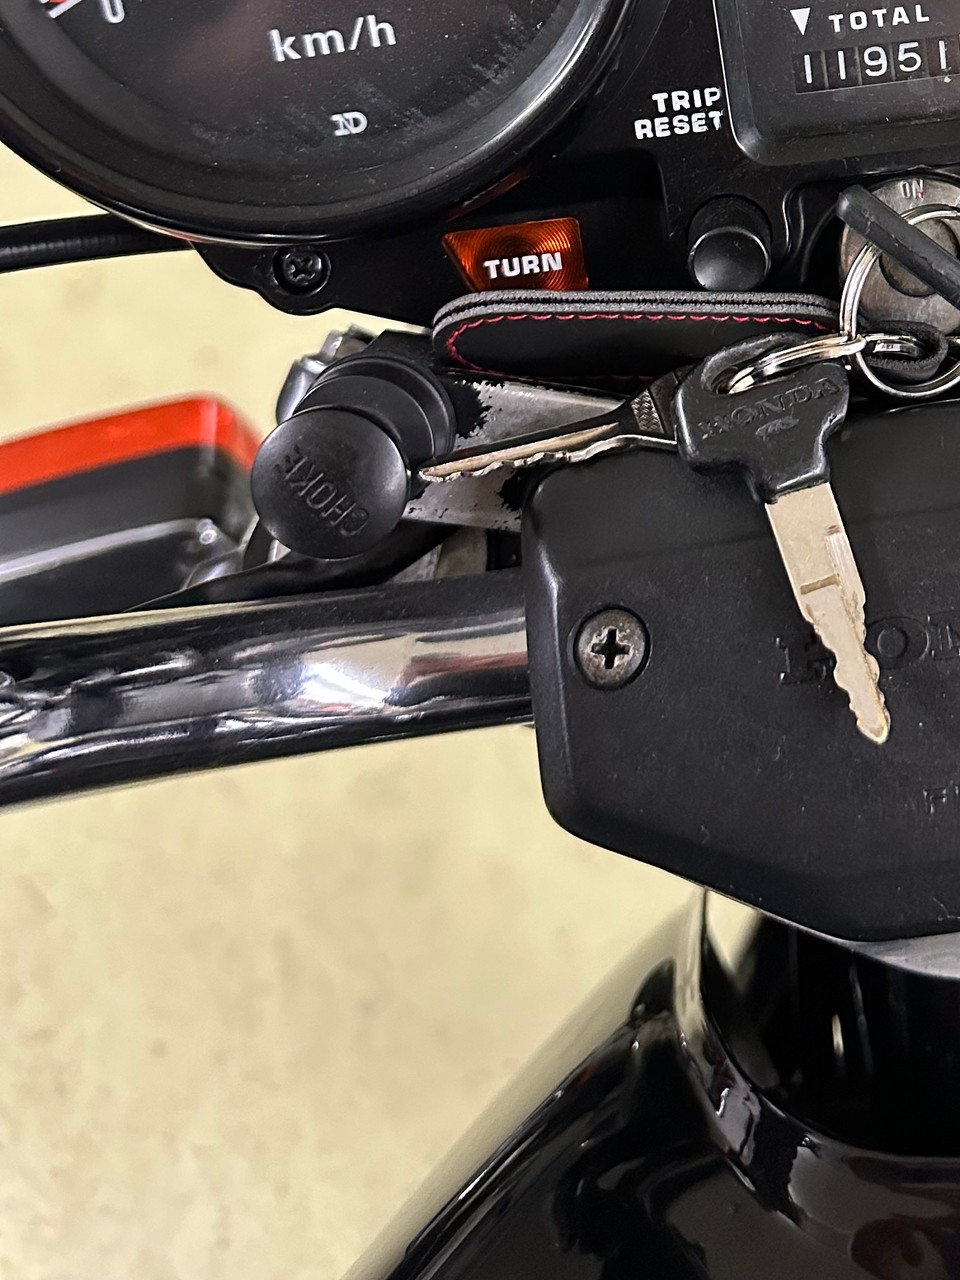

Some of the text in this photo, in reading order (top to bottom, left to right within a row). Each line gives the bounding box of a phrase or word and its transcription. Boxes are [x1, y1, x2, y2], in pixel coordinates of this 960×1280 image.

[828, 4, 930, 33] TOTAL
[267, 13, 397, 62] km/h
[651, 87, 722, 113] TRIP
[634, 110, 724, 140] RESET
[899, 178, 925, 200] ON
[483, 251, 564, 280] TURN
[273, 441, 370, 537] CHOKE
